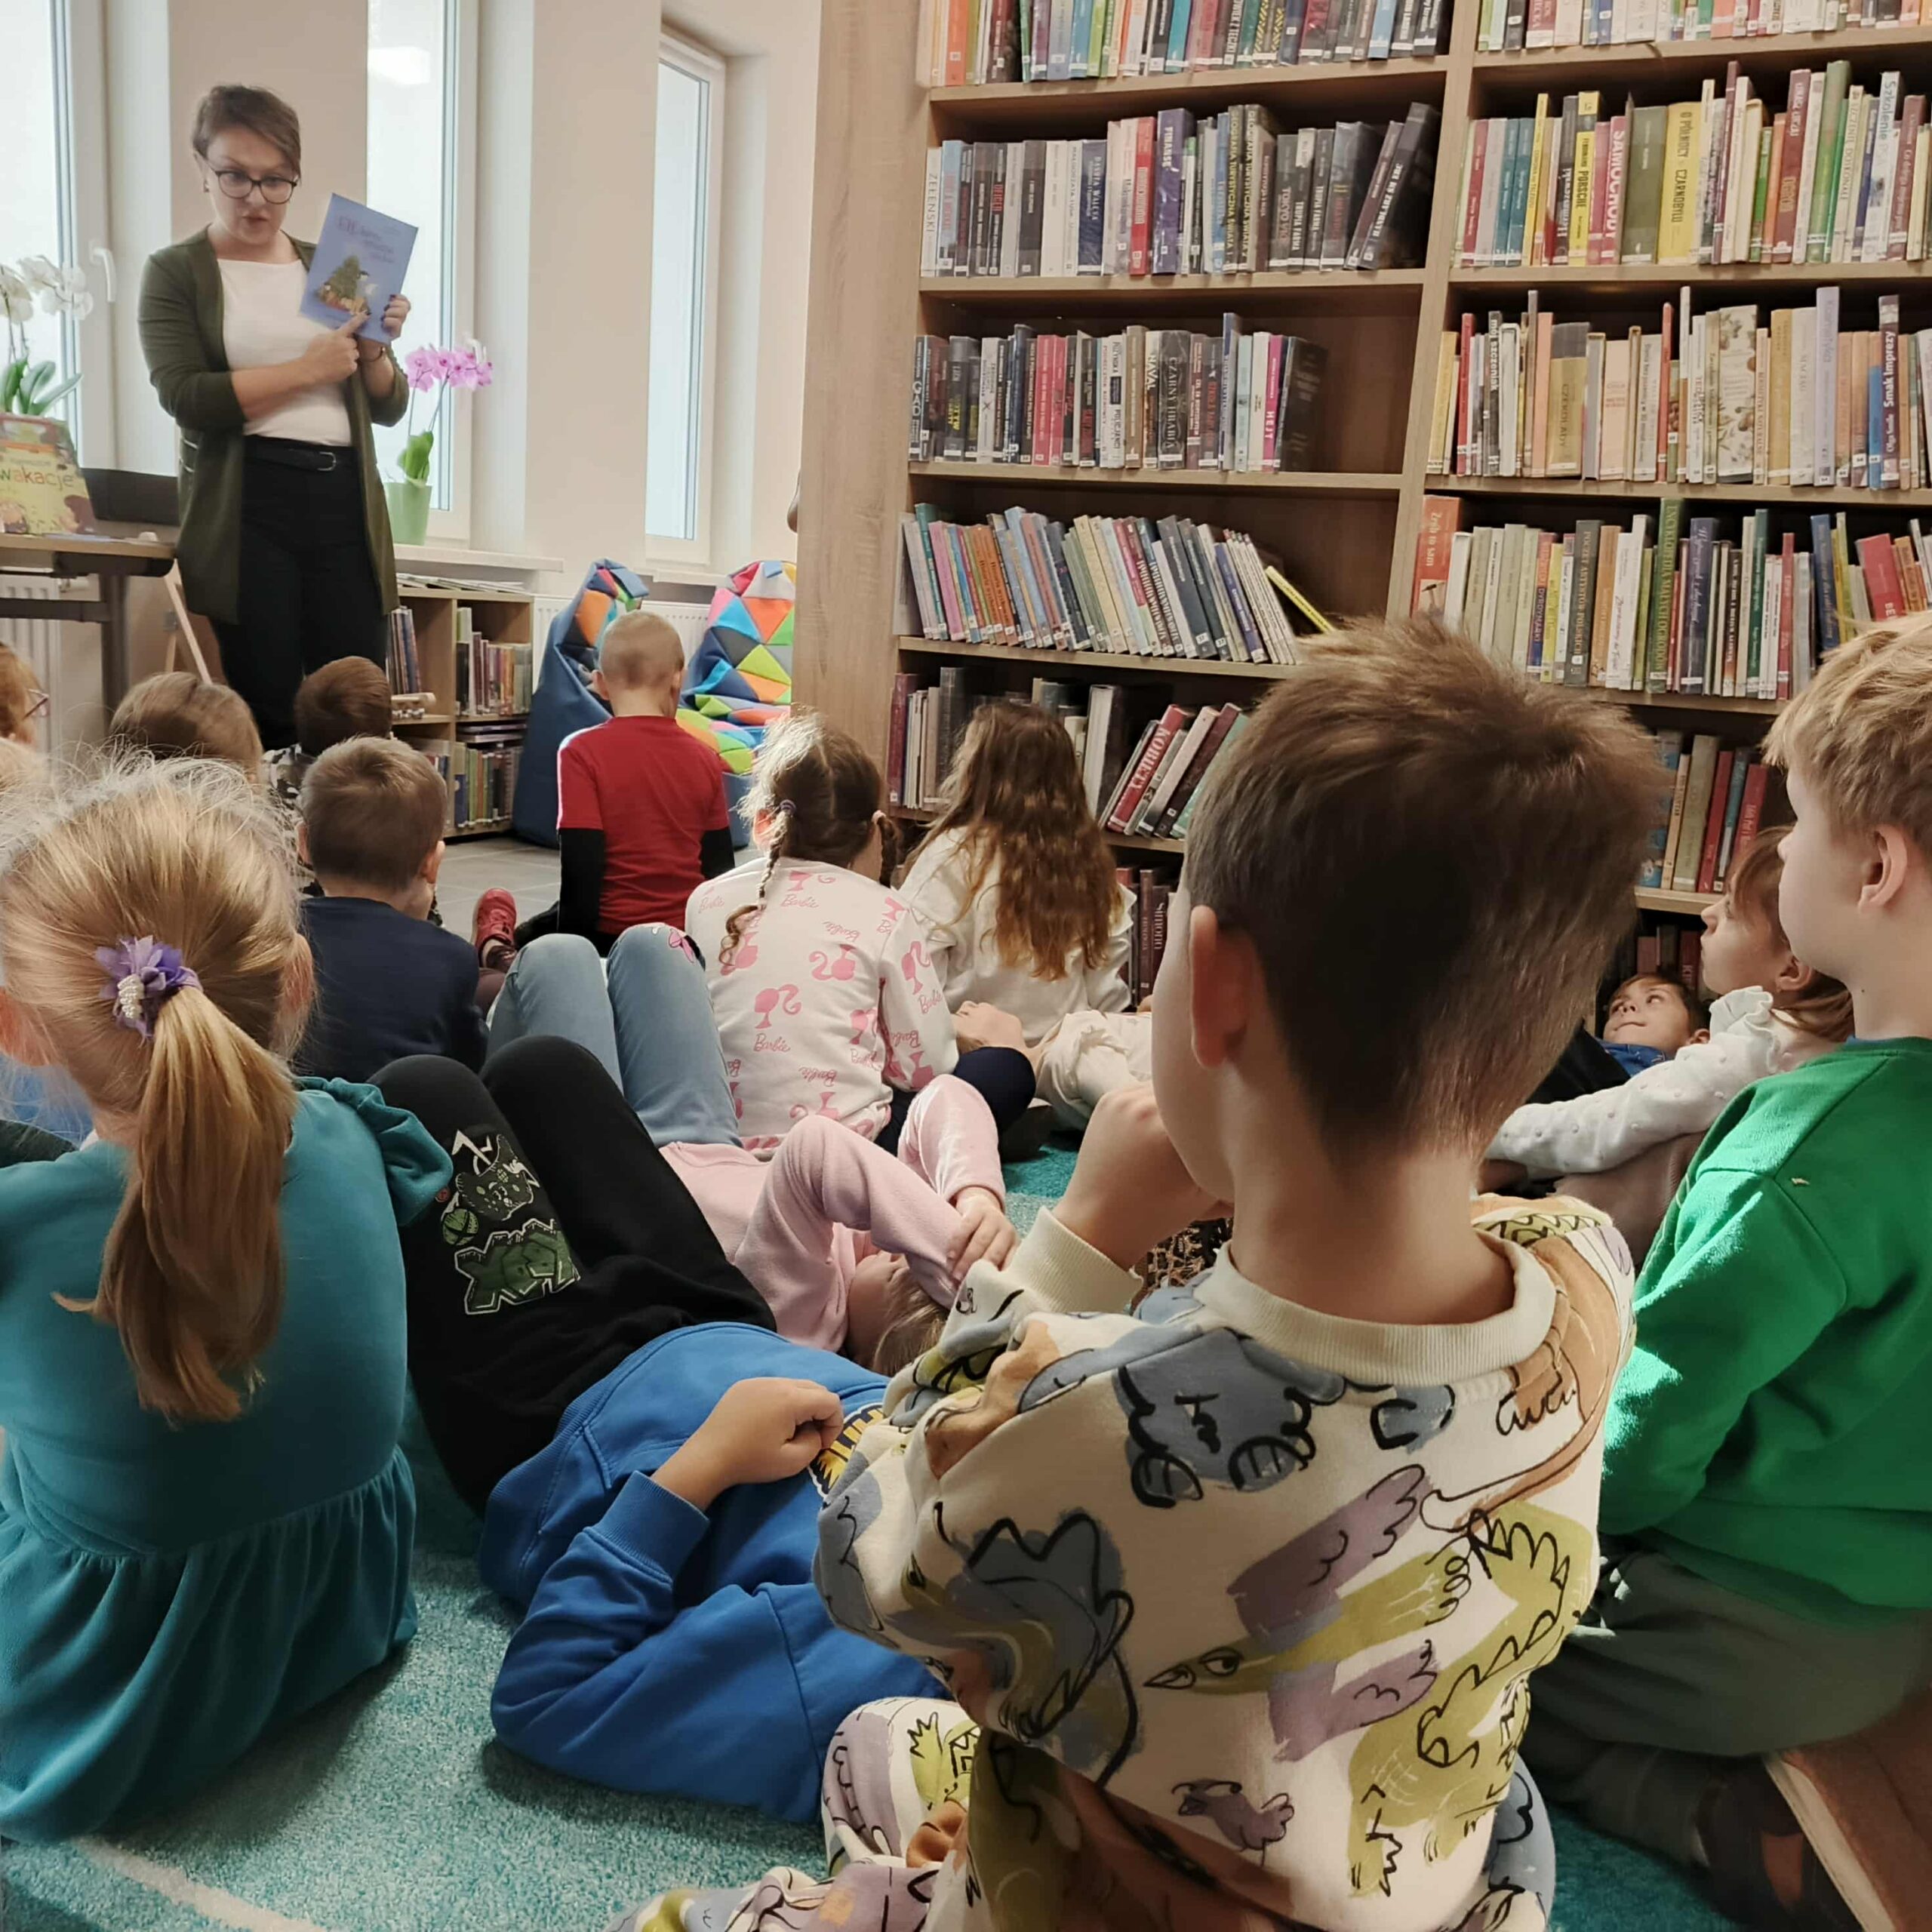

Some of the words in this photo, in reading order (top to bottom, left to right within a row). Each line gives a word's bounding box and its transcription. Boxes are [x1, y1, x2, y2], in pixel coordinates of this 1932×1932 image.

[1878, 81, 1896, 141] Szkolenie
[1162, 126, 1174, 168] FINANSE
[1229, 111, 1239, 160] GEOGRAFIA
[1245, 110, 1256, 162] GEOGRAFIA
[1677, 120, 1694, 158] PÓŁNOCY
[1227, 161, 1238, 217] TURYSTYCZNA
[1243, 163, 1254, 217] TURYSTYCZNA
[1314, 186, 1324, 208] TRUPIA
[1557, 168, 1572, 237] Hermaszewski
[1576, 170, 1589, 209] PORSCHE
[1604, 130, 1625, 239] SAMOCHODY
[1671, 168, 1687, 223] CZARNOBYLU
[1281, 186, 1291, 222] TOKYO
[1293, 201, 1304, 226] TRUPIA
[1312, 209, 1322, 232] FARMA
[1372, 193, 1393, 237] HANDLARZ
[1291, 227, 1303, 251] FARMA
[1489, 318, 1500, 338] mój
[1146, 354, 1158, 390] NAVAL
[1490, 340, 1500, 392] szczeniak
[1882, 331, 1896, 377] Imprezy
[1168, 356, 1177, 402] CZARNY
[1884, 377, 1894, 408] Smak
[912, 380, 923, 417] GAD
[1558, 383, 1570, 448] CZEKOLADY
[1113, 408, 1121, 449] POLICJANCI
[1167, 406, 1177, 449] HRABIA
[1264, 410, 1275, 440] HEJT
[0, 465, 74, 491] wakacje
[1428, 535, 1437, 546] to
[1429, 512, 1441, 534] Zrób
[1660, 505, 1678, 577] ENCYKLOPEDIA
[1426, 547, 1435, 567] sam
[1580, 531, 1592, 564] POCZET
[1574, 611, 1585, 655] POLSKICH
[1128, 724, 1172, 792] KOBIETY
[782, 894, 820, 909] Barbie
[823, 921, 861, 943] Barbie
[917, 992, 943, 1015] Barbie
[753, 1033, 791, 1053] Barbie
[798, 1066, 838, 1088] Barbie
